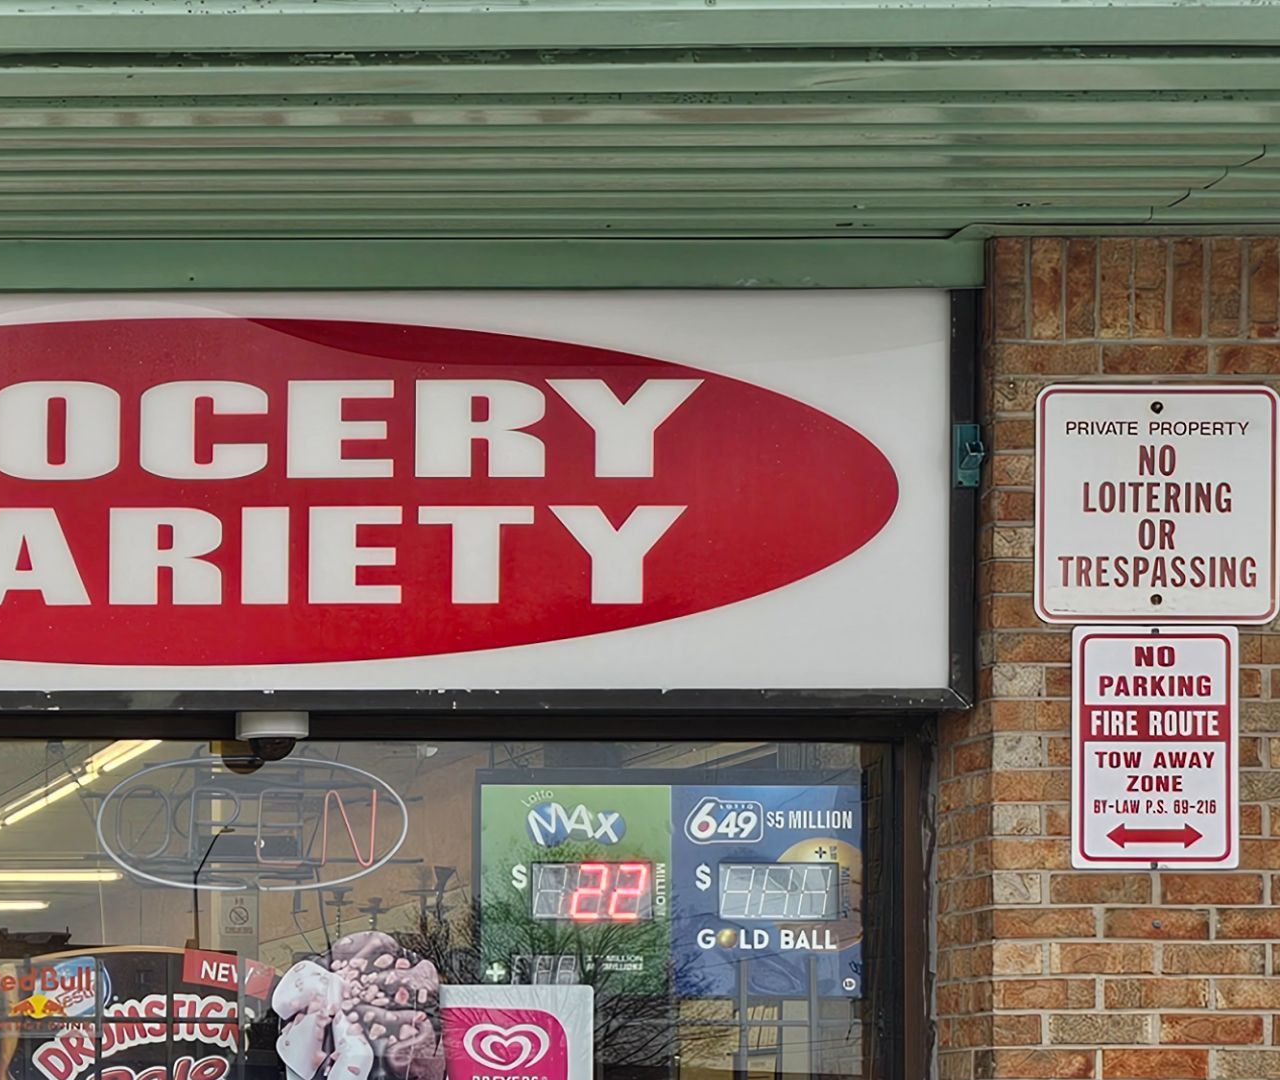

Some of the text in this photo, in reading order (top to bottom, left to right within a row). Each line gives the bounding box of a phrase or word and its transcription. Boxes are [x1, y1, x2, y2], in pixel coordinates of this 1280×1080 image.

[1066, 421, 1251, 436] PRIVATE PROPERTY
[1138, 443, 1177, 477] NO
[1083, 482, 1233, 514] LOITERING
[1138, 518, 1176, 551] OR
[1058, 555, 1257, 589] TRESPASSING
[1134, 645, 1175, 668] NO
[1099, 675, 1212, 697] PARKING
[1090, 711, 1220, 737] FIRE ROUTE
[1095, 751, 1216, 769] TOW AWAY
[1127, 774, 1184, 793] ZONE
[521, 789, 553, 808] Lotto
[1094, 799, 1140, 814] BY-LAW
[1145, 799, 1168, 814] P.S.
[115, 787, 377, 867] OPEN
[690, 802, 853, 839] 649 $5 MILLION
[570, 863, 648, 920] 22
[781, 929, 837, 950] BALL
[40, 966, 92, 992] Bull
